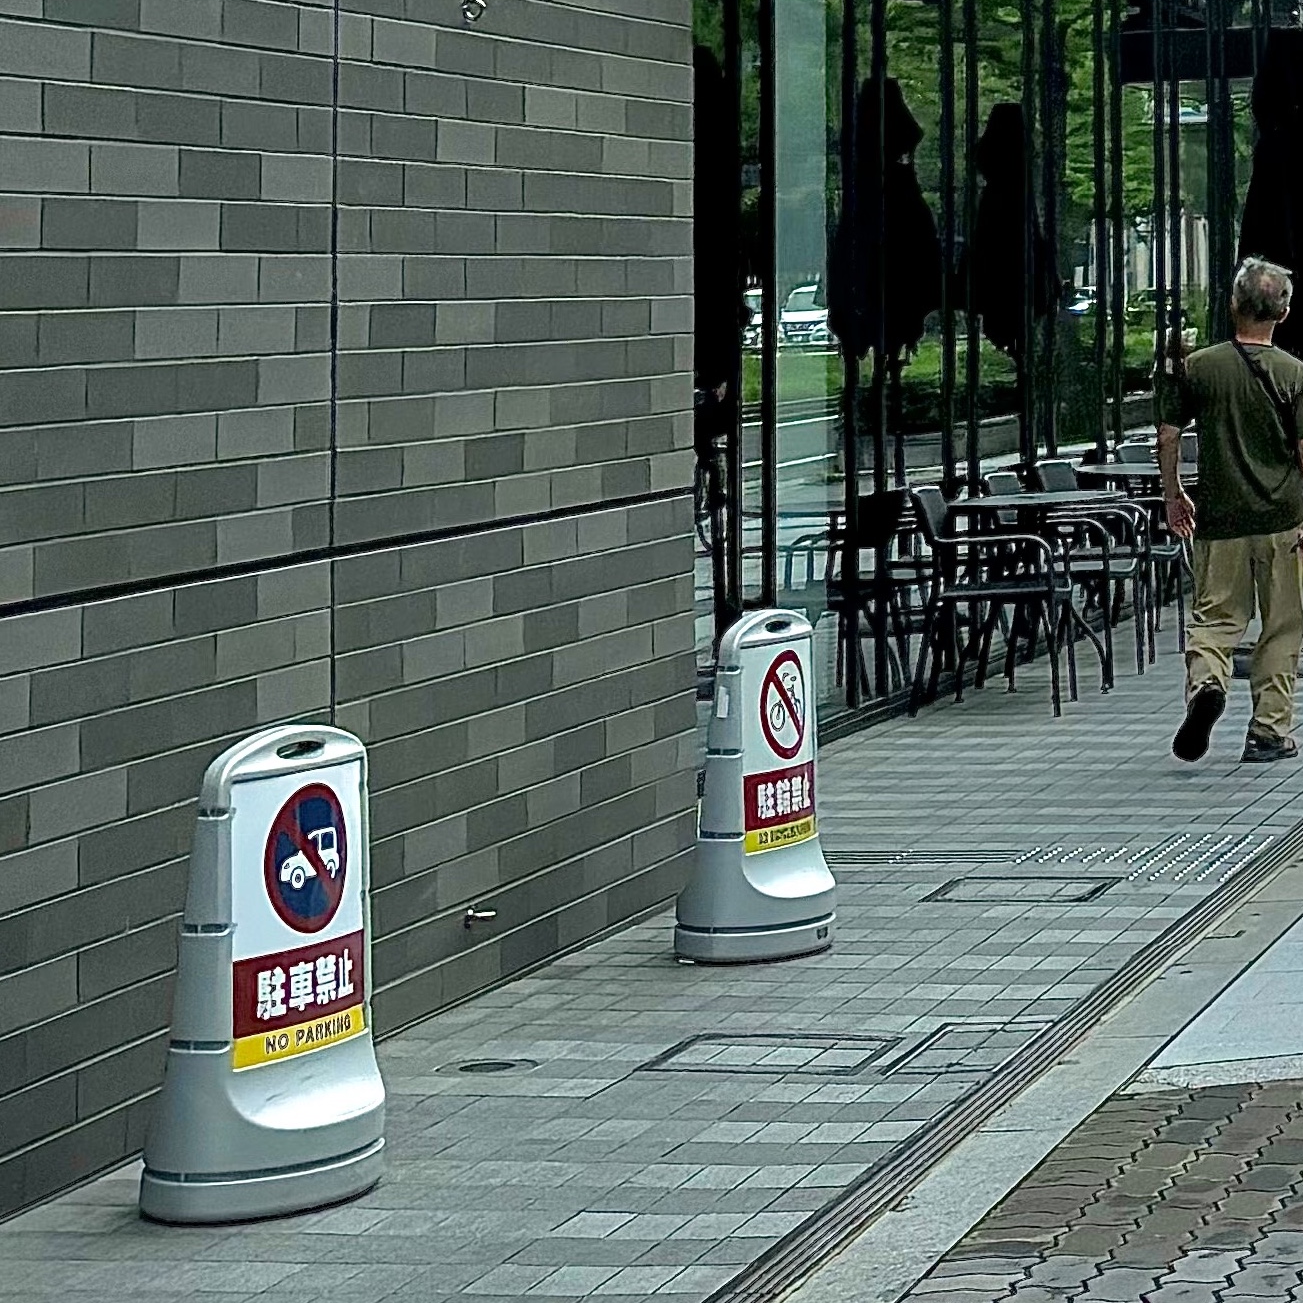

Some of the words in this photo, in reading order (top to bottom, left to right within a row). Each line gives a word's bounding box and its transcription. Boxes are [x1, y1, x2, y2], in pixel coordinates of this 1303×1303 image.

[256, 947, 354, 1021] 駐車禁止
[265, 1033, 290, 1055] NO
[296, 1013, 352, 1047] PARKING
